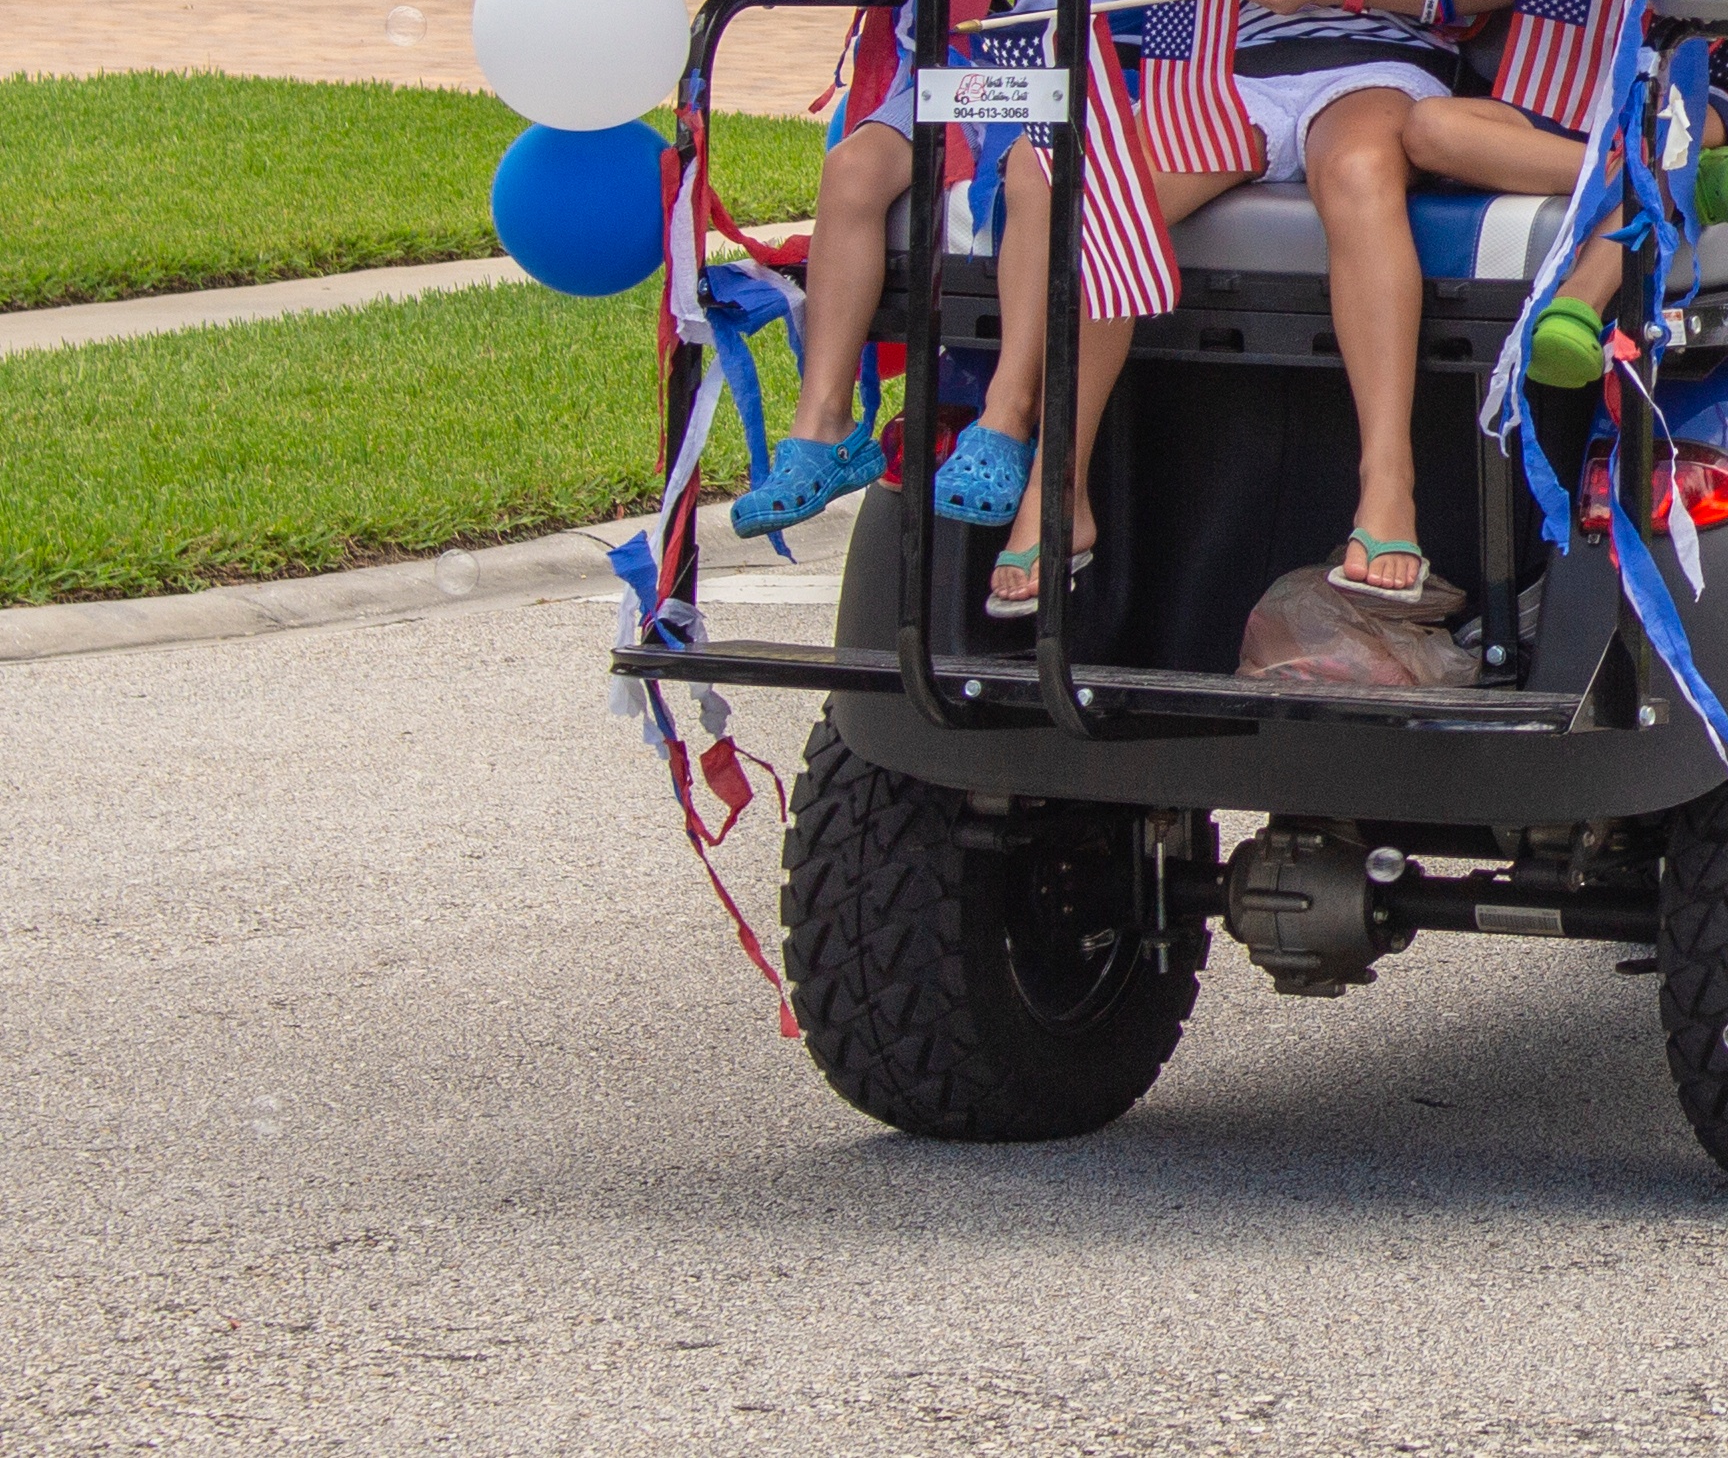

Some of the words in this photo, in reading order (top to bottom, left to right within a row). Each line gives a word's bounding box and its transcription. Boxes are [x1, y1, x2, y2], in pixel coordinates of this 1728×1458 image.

[985, 76, 1003, 88] North
[1005, 76, 1029, 88] Florida
[954, 107, 1029, 118] 904-613-3068
